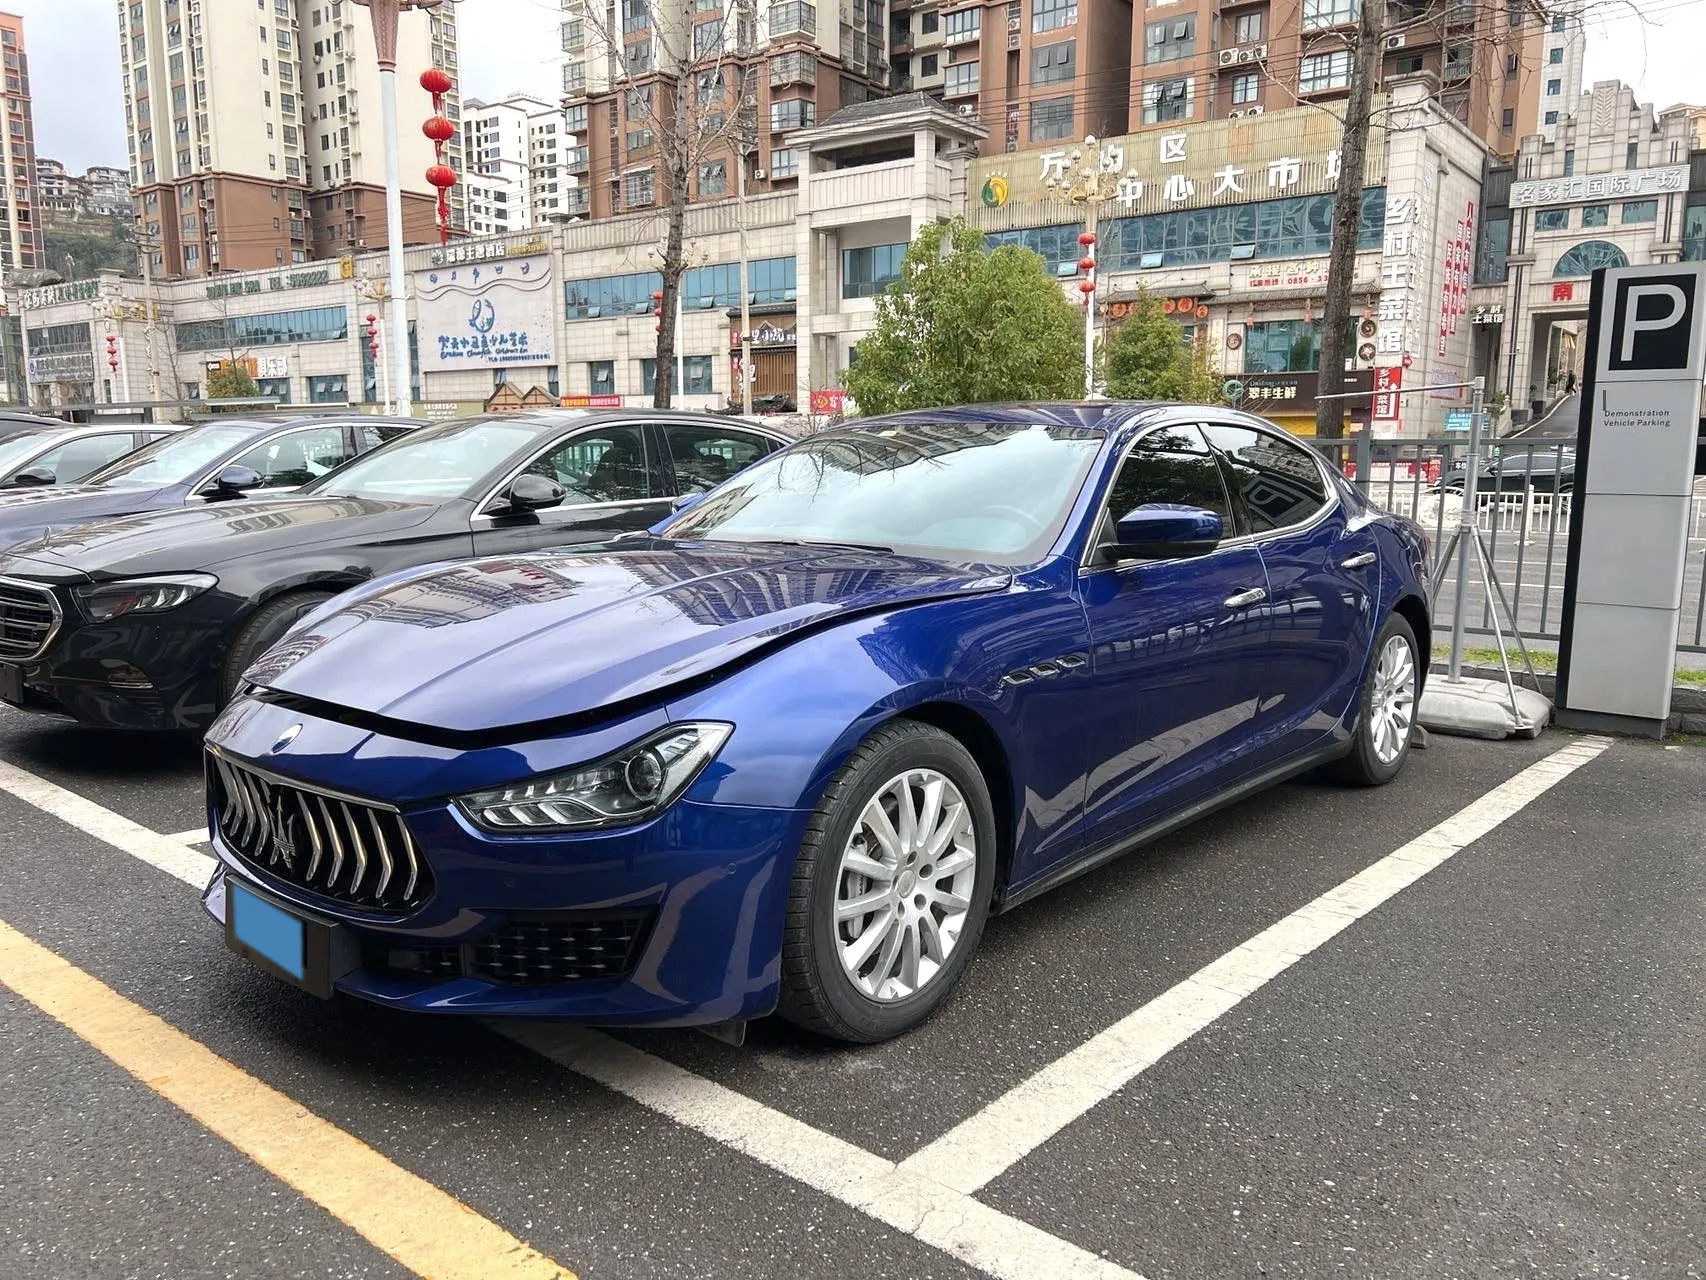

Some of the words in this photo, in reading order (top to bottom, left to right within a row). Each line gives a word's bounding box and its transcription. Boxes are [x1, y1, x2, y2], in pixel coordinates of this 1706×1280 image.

[1517, 169, 1682, 204] 名家汇国际广场
[1552, 281, 1574, 301] 南
[1621, 284, 1687, 361] P
[1248, 386, 1297, 400] 翠丰生鲜
[1603, 419, 1635, 427] Vehicle
[1637, 419, 1671, 428] Parking
